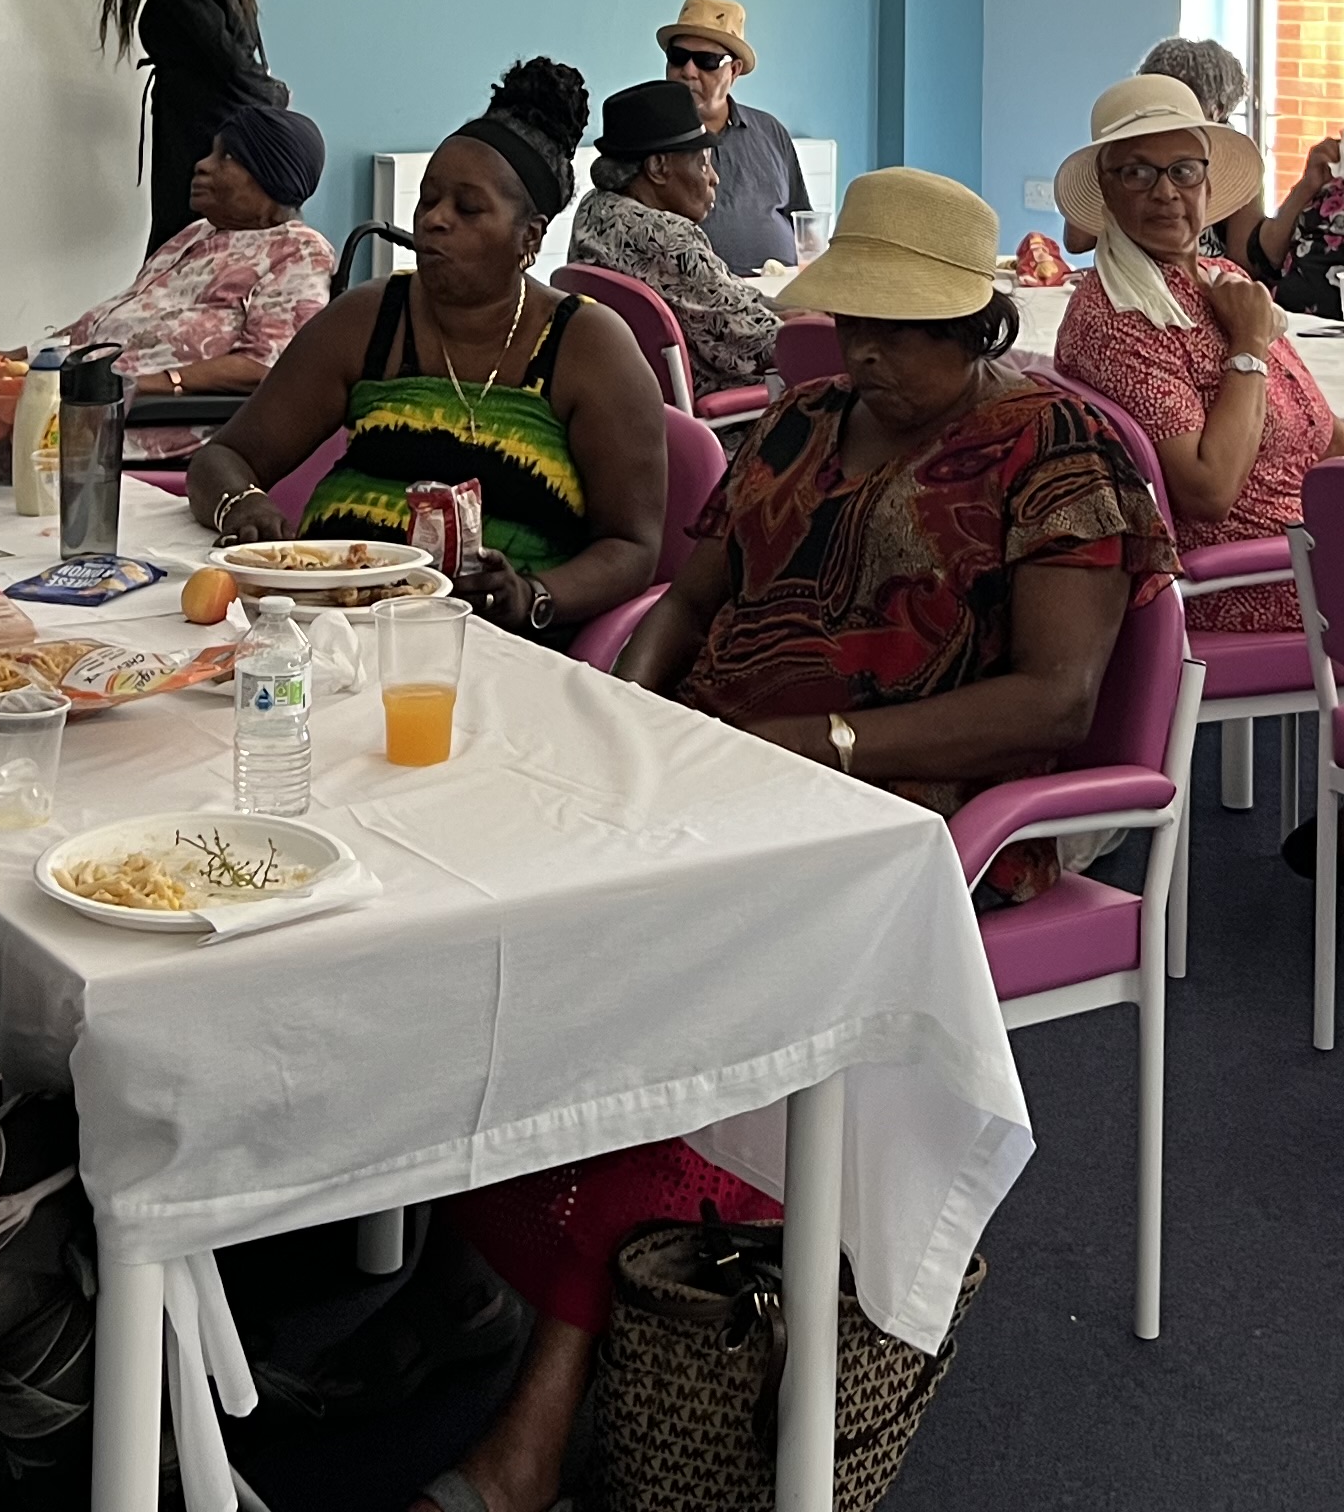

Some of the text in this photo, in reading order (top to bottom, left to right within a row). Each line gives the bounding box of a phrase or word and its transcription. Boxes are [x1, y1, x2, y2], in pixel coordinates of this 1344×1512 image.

[44, 574, 102, 588] CHEESE
[57, 565, 103, 577] ONION
[842, 1350, 865, 1374] MK
[875, 1357, 900, 1381] MK
[676, 1384, 706, 1405] MK
[860, 1381, 885, 1404] MK
[888, 1374, 910, 1397] MK
[709, 1388, 739, 1410] MK
[871, 1398, 894, 1420] MK
[688, 1407, 717, 1428] MK
[720, 1412, 752, 1434] MK
[844, 1406, 870, 1427] MK
[668, 1422, 699, 1443] MK
[700, 1430, 731, 1449] MK
[679, 1444, 709, 1463] MK
[712, 1451, 742, 1469] MK
[871, 1446, 895, 1468] MK
[659, 1458, 690, 1478] MK
[690, 1465, 722, 1485] MK
[845, 1454, 870, 1476] MK
[670, 1479, 701, 1499] MK
[854, 1469, 878, 1491] MK
[702, 1486, 735, 1504] MK
